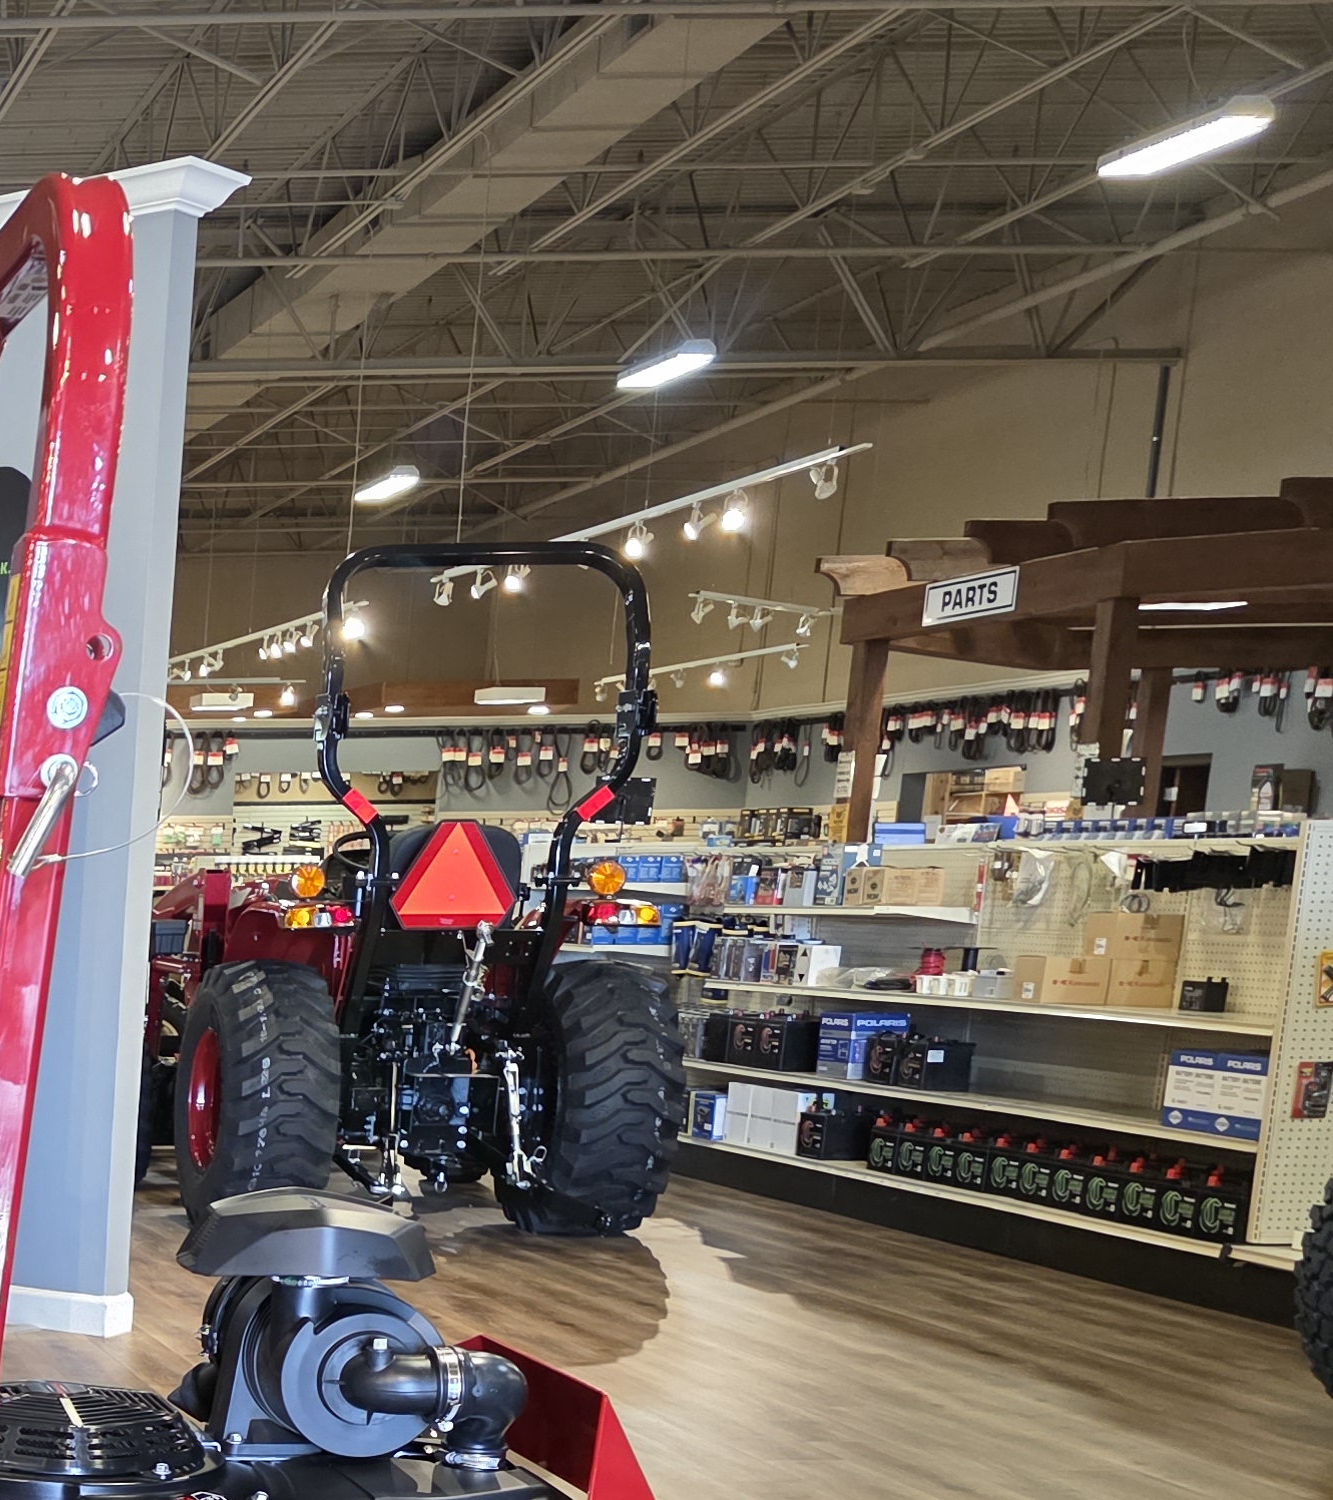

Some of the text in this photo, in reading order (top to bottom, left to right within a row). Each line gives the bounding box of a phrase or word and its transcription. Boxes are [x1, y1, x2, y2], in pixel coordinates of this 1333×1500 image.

[941, 581, 998, 612] PARTS
[821, 1016, 849, 1027] POLARIS
[856, 1018, 907, 1027] POLARIS
